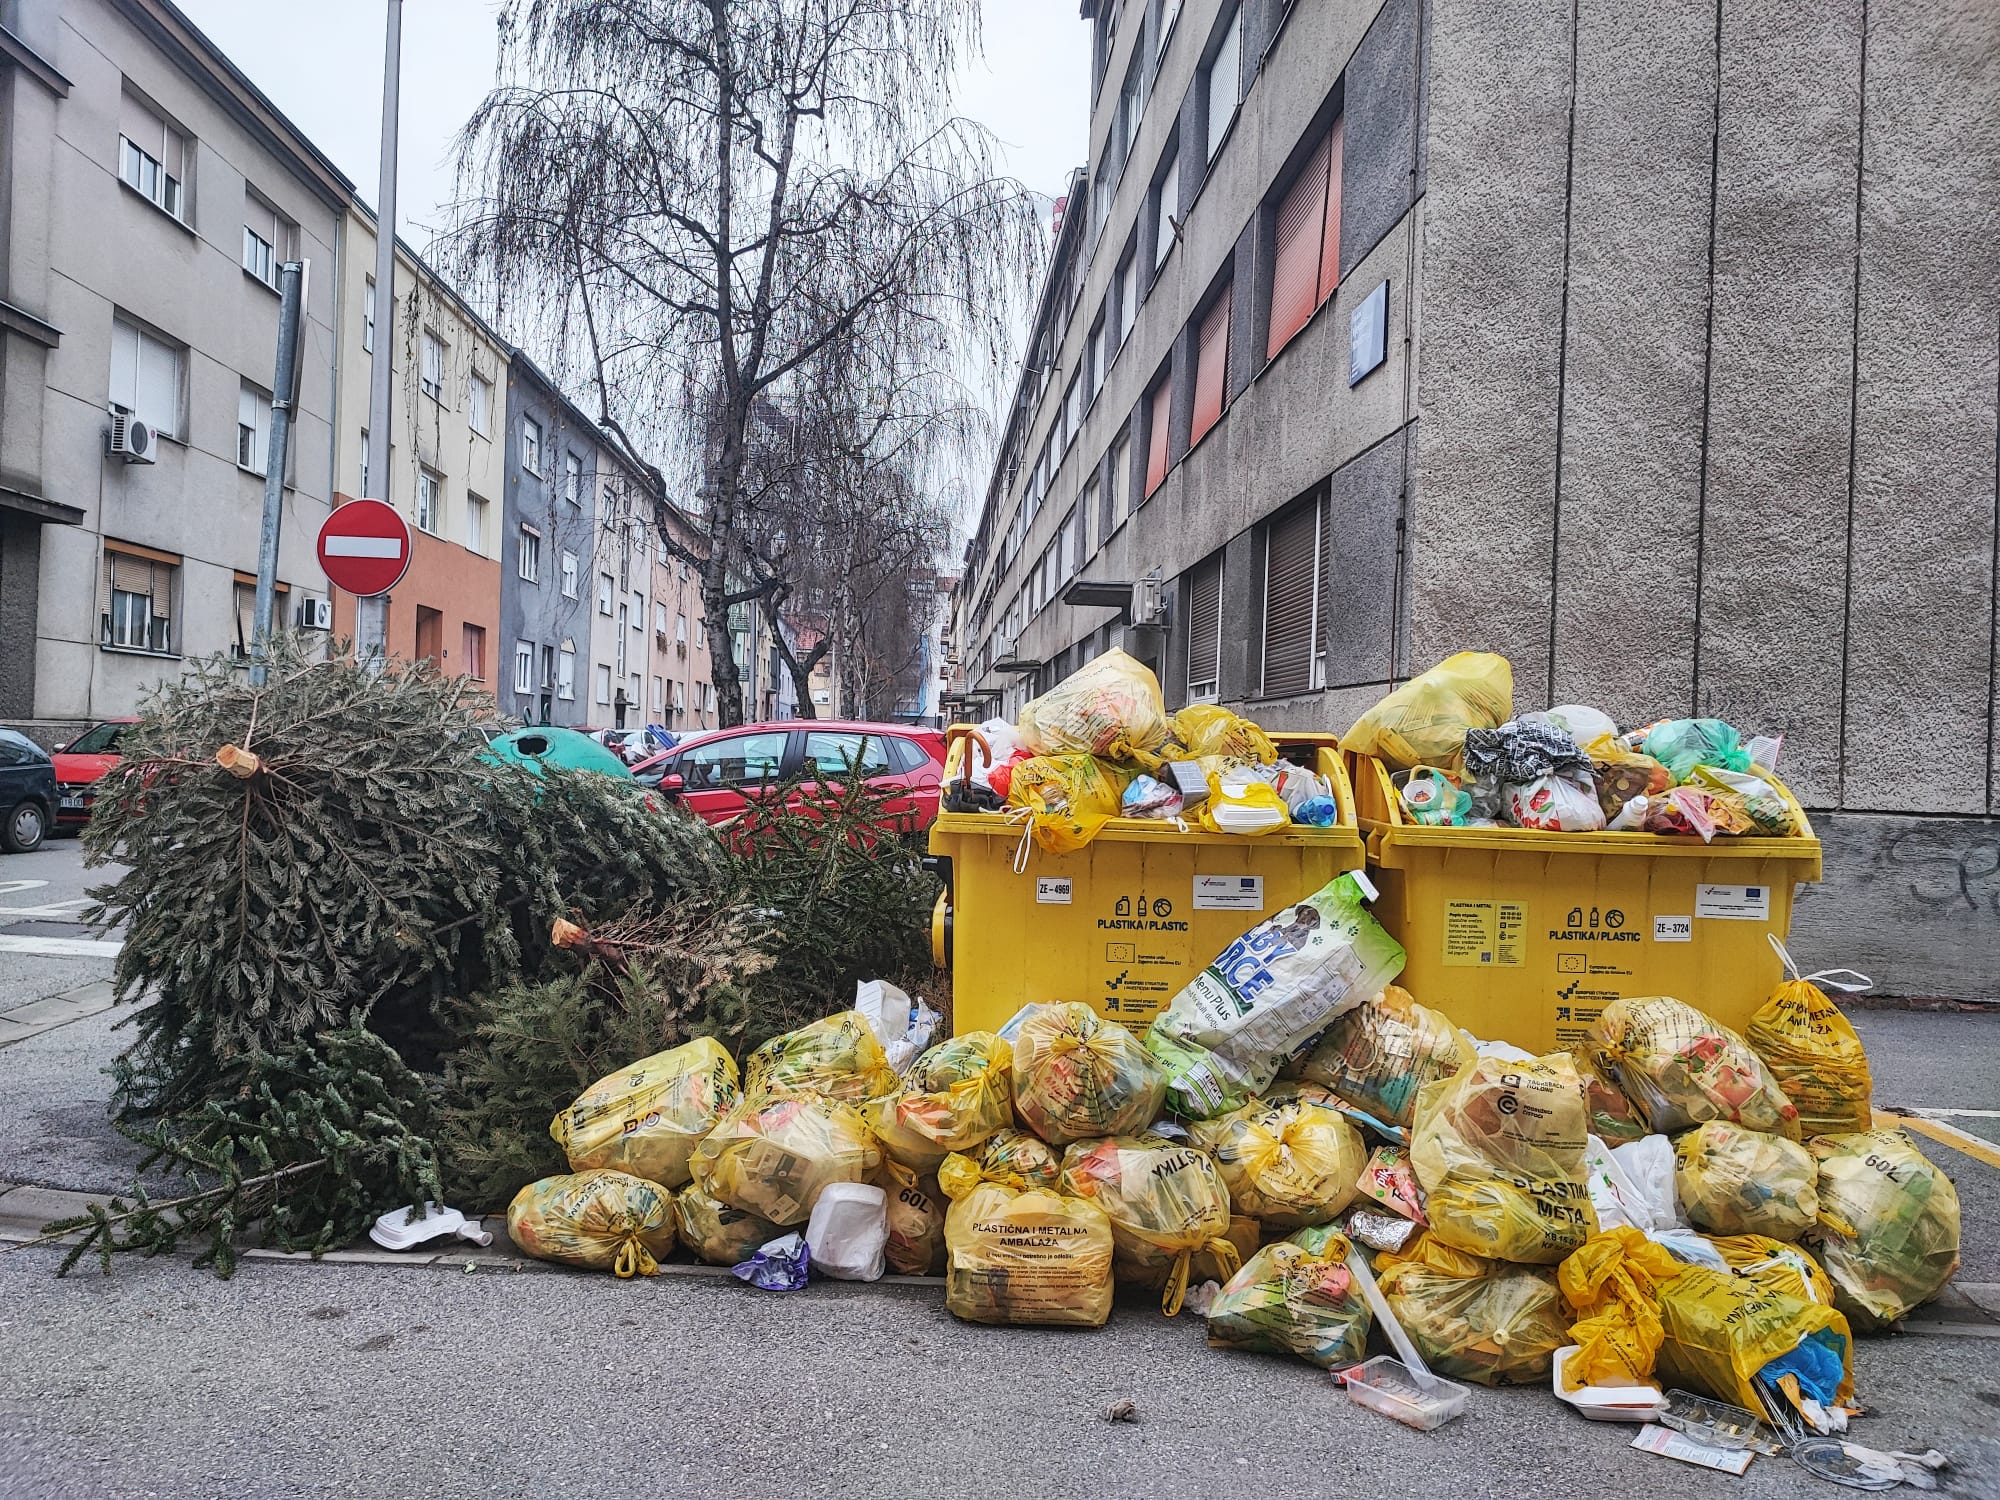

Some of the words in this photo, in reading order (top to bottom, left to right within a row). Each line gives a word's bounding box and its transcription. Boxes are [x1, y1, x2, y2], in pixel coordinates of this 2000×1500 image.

[1209, 996, 1231, 1021] Plus
[1864, 1154, 1899, 1184] 60L
[899, 1188, 928, 1214] 60L
[972, 1222, 1030, 1234] PLASTIČNA
[1038, 1226, 1088, 1236] METALNA
[1000, 1237, 1060, 1247] AMBALAŽA
